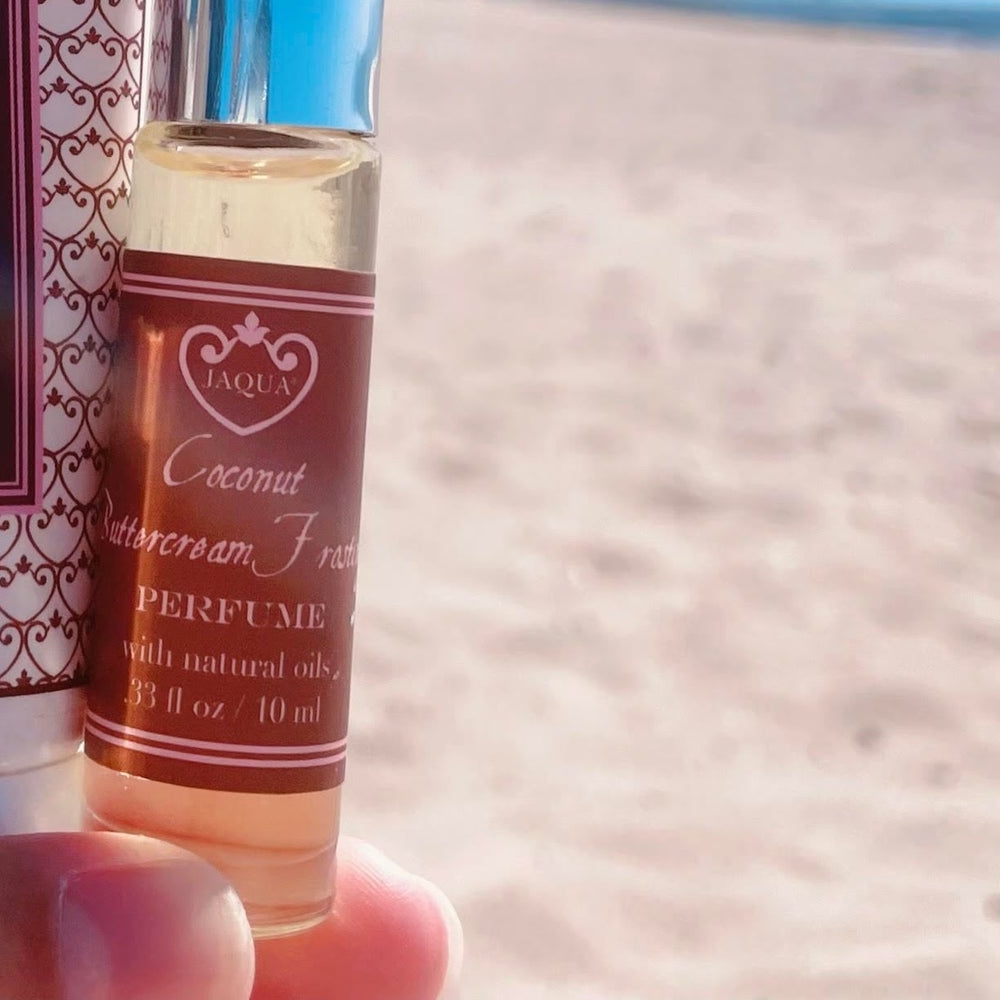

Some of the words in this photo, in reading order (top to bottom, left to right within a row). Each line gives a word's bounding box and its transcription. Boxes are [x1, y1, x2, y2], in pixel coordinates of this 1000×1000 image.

[163, 433, 307, 495] Coconut
[137, 585, 326, 630] PERFUME
[123, 635, 173, 669] with
[182, 650, 285, 680] natural
[192, 698, 225, 720] oz
[258, 695, 286, 724] 10
[293, 696, 321, 723] ml
